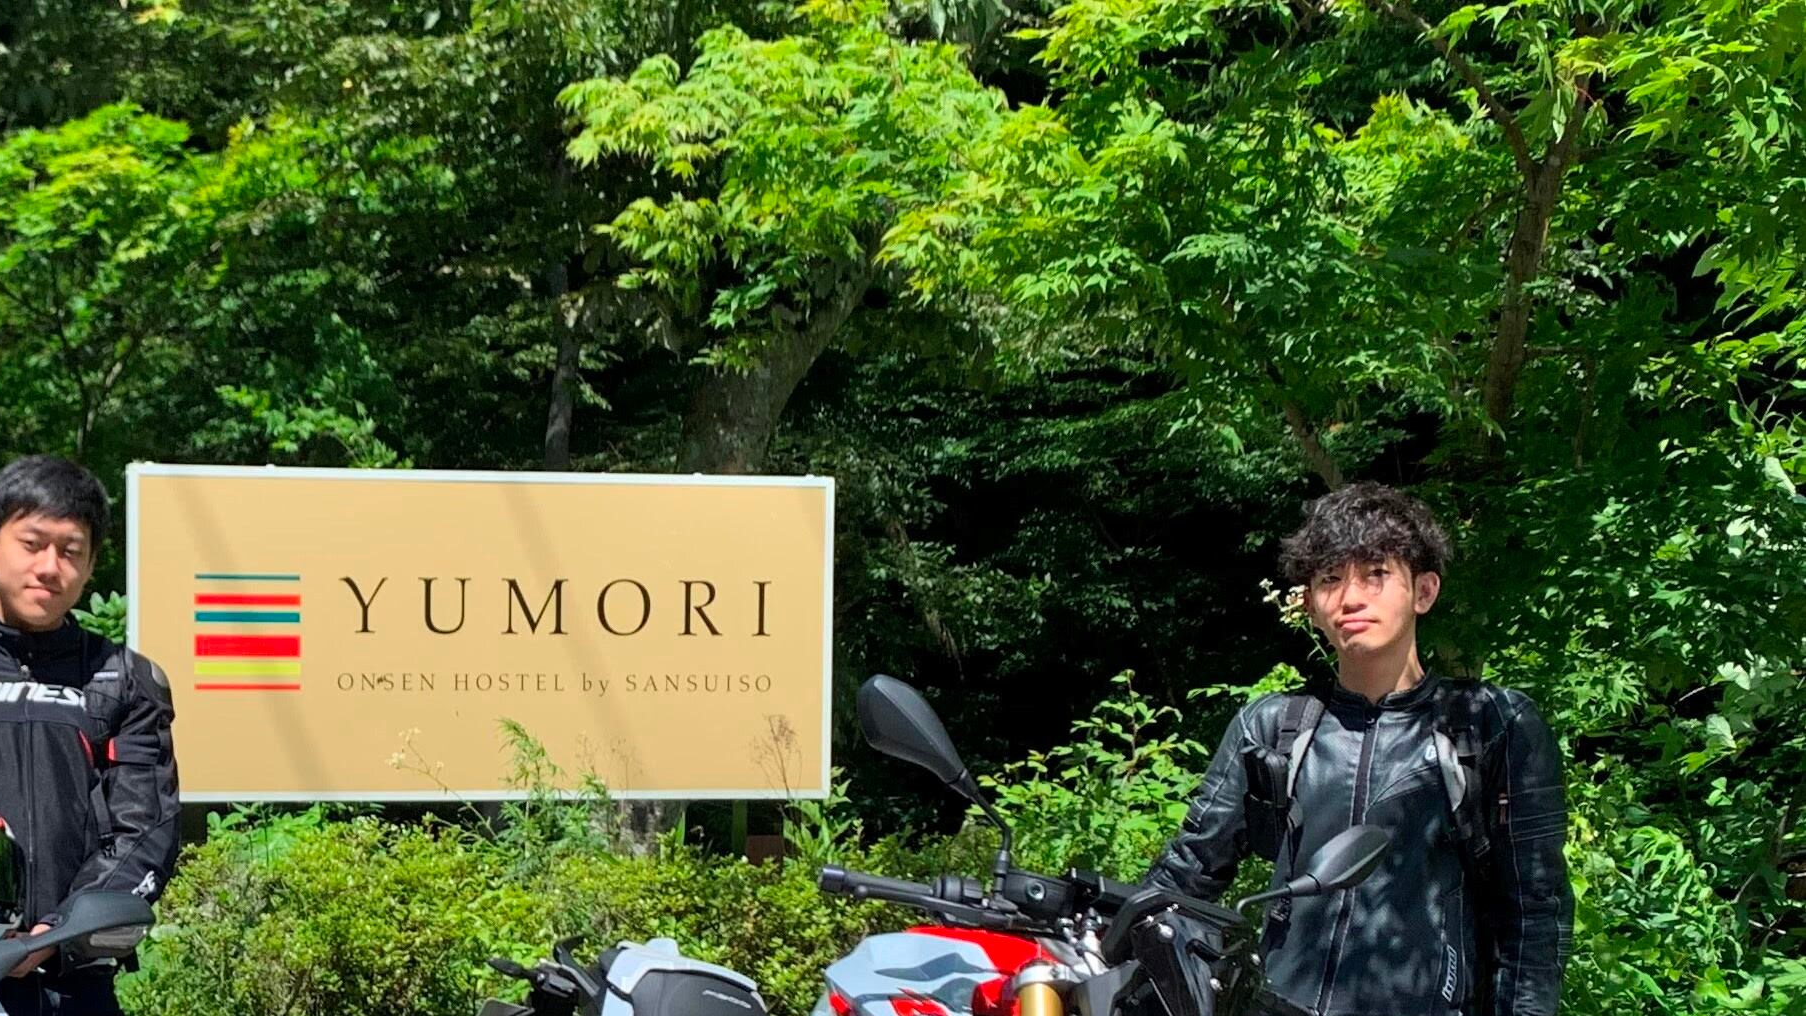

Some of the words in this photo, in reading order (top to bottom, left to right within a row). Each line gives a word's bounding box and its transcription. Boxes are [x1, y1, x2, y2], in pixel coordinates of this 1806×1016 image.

[338, 576, 772, 637] YUMORI
[337, 672, 435, 691] ONSEN
[454, 673, 564, 692] HOSTEL
[582, 672, 609, 696] by
[626, 674, 772, 692] SANSUISO
